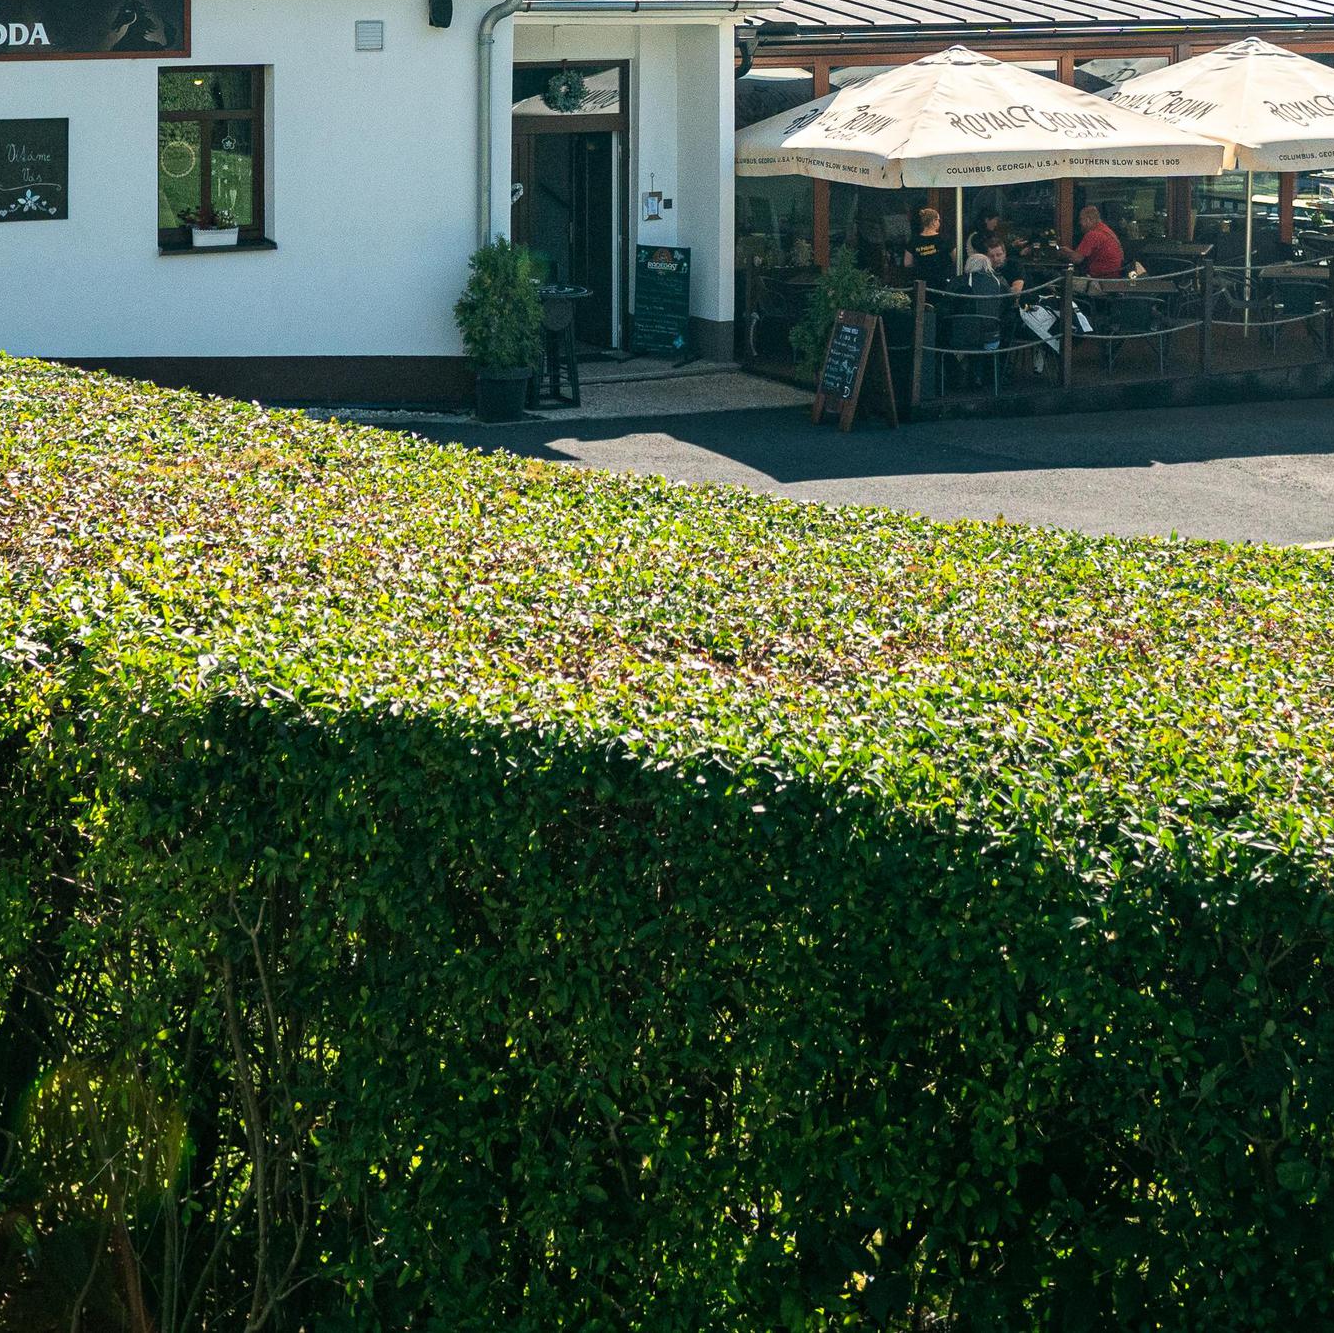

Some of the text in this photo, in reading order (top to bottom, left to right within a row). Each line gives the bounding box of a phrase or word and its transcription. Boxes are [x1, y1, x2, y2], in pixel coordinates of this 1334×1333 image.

[1143, 90, 1218, 120] CROWN
[945, 105, 1118, 139] ROYAL CROWN
[1069, 157, 1110, 166] SOUTHERN
[1111, 158, 1134, 166] SLOW
[1161, 158, 1180, 166] 1905
